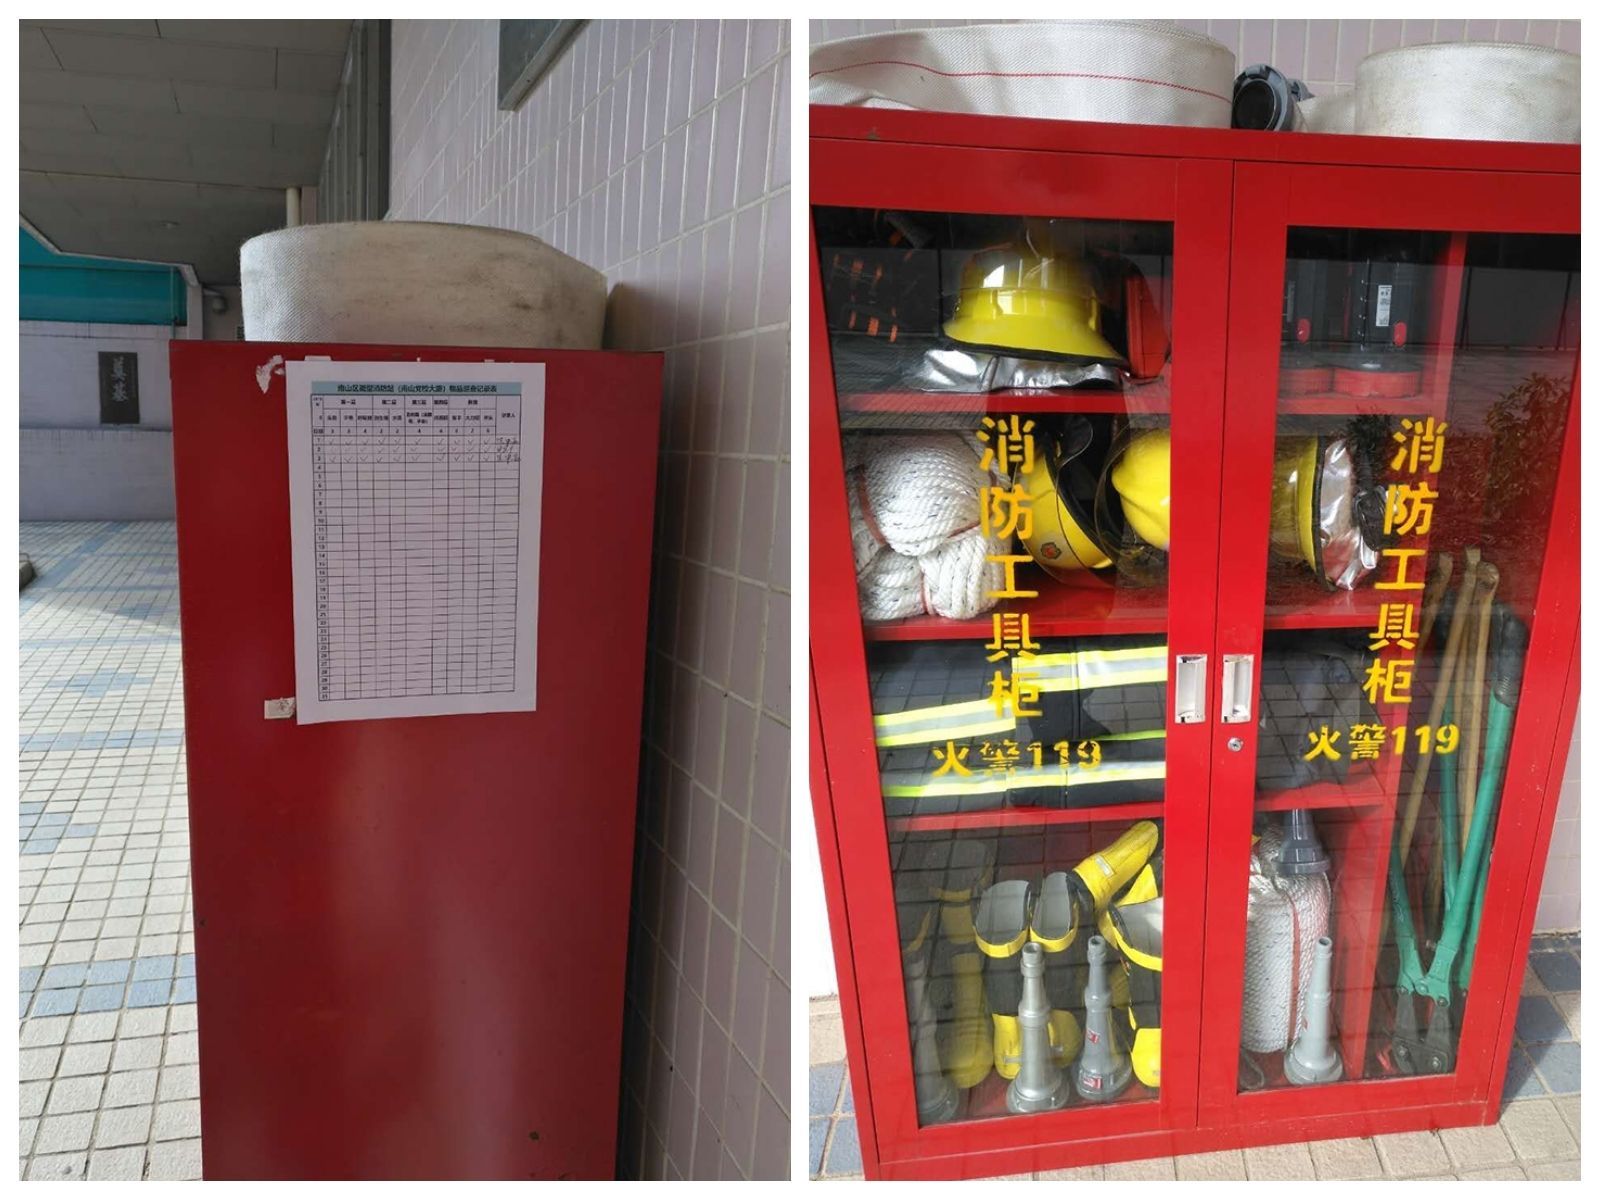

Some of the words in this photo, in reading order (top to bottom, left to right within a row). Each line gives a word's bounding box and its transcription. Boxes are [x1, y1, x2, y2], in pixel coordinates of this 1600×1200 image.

[976, 415, 1042, 717] 消防工具柜
[1363, 417, 1447, 704] 消防工具柜
[932, 739, 1101, 777] 火警119
[1304, 724, 1461, 761] 火警119
